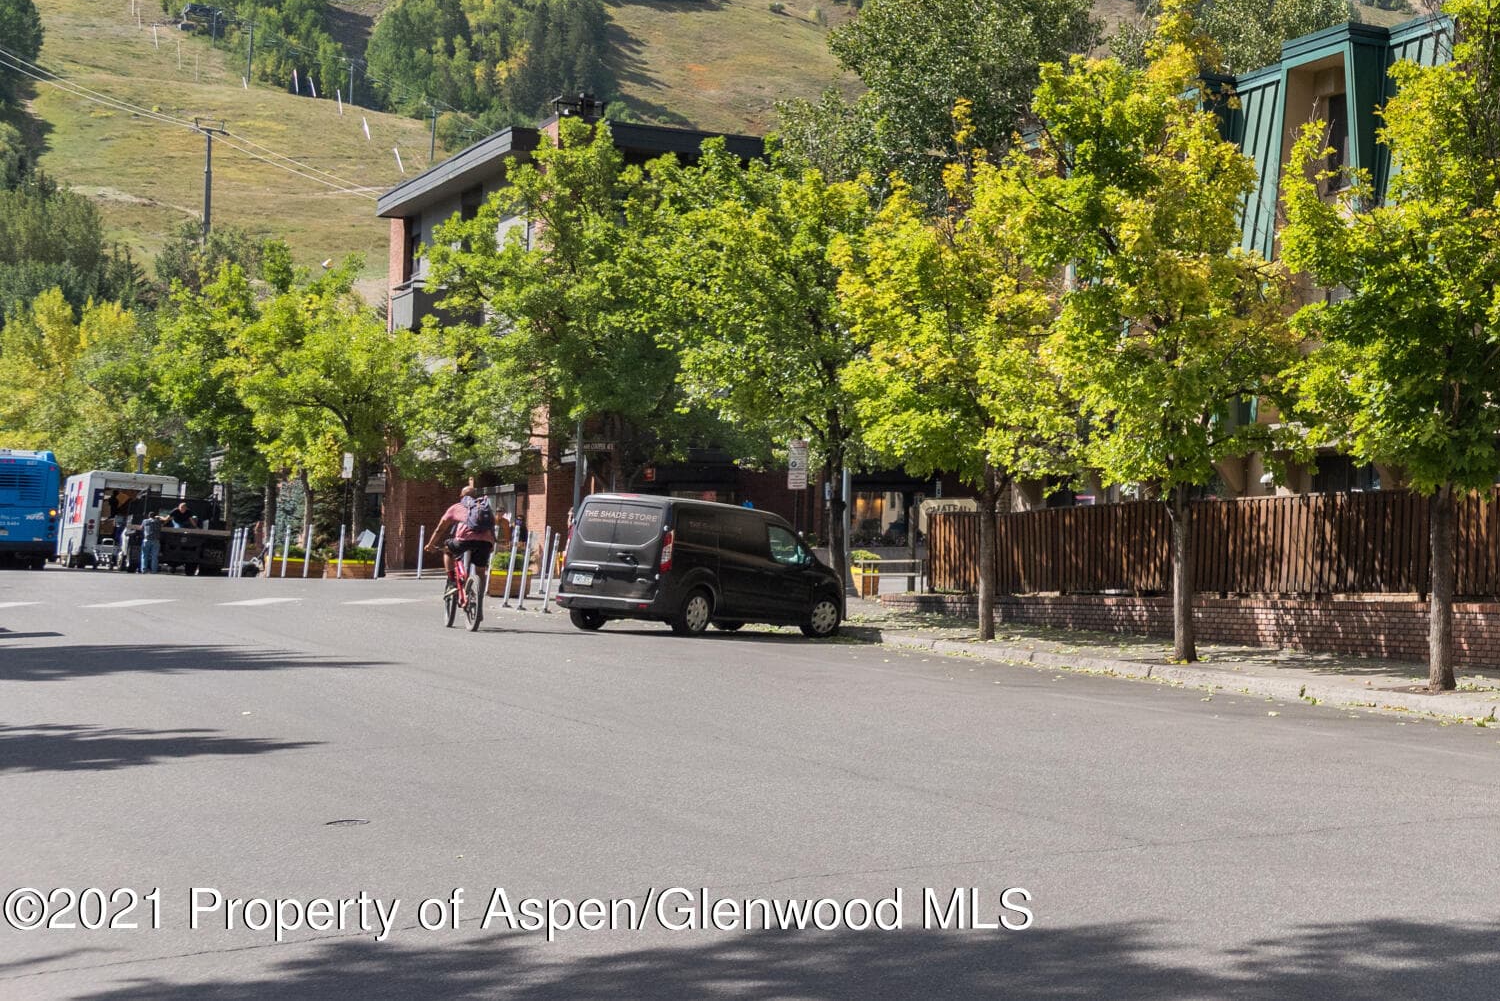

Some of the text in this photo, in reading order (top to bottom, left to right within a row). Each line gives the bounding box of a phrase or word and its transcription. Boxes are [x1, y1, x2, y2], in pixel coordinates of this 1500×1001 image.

[585, 510, 599, 518] THE
[600, 510, 626, 520] SHADE
[627, 512, 658, 523] STORE
